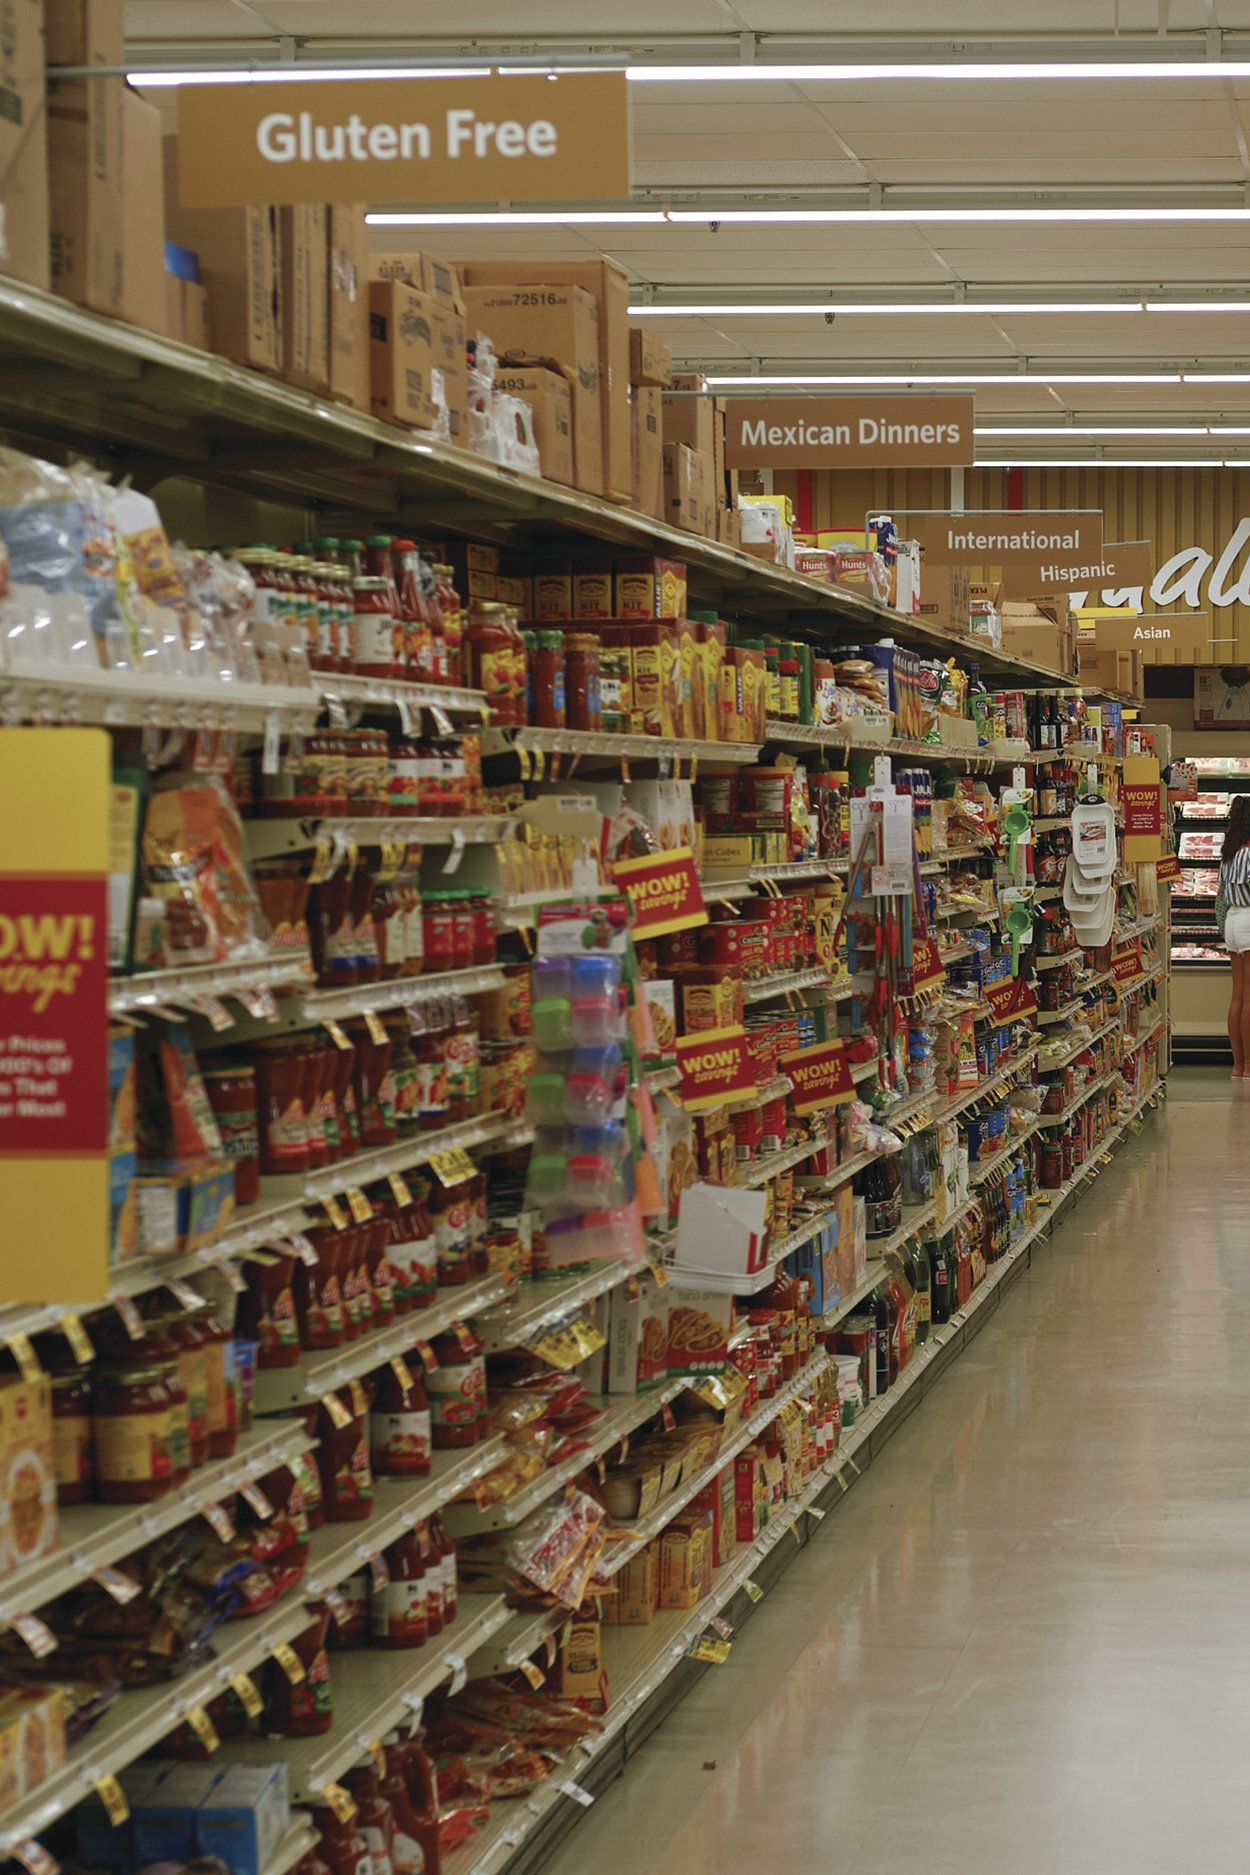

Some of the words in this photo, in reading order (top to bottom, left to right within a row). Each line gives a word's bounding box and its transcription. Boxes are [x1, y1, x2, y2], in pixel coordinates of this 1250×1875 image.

[257, 112, 431, 162] Gluten
[446, 109, 558, 158] Free
[741, 419, 851, 447] Mexican
[858, 418, 960, 445] Dinners
[947, 530, 1080, 550] International
[1040, 561, 1115, 582] Hispanic
[623, 601, 642, 609] KIT
[1133, 626, 1171, 640] Asian
[1126, 791, 1158, 801] WOW!
[1158, 861, 1176, 871] WOW!
[626, 872, 691, 899] WOW!
[639, 890, 688, 910] savings
[1115, 959, 1137, 972] WOW!
[683, 1048, 741, 1074] WOW!
[792, 1059, 842, 1083] WOW!
[694, 1064, 738, 1084] savings
[803, 1072, 840, 1090] savings
